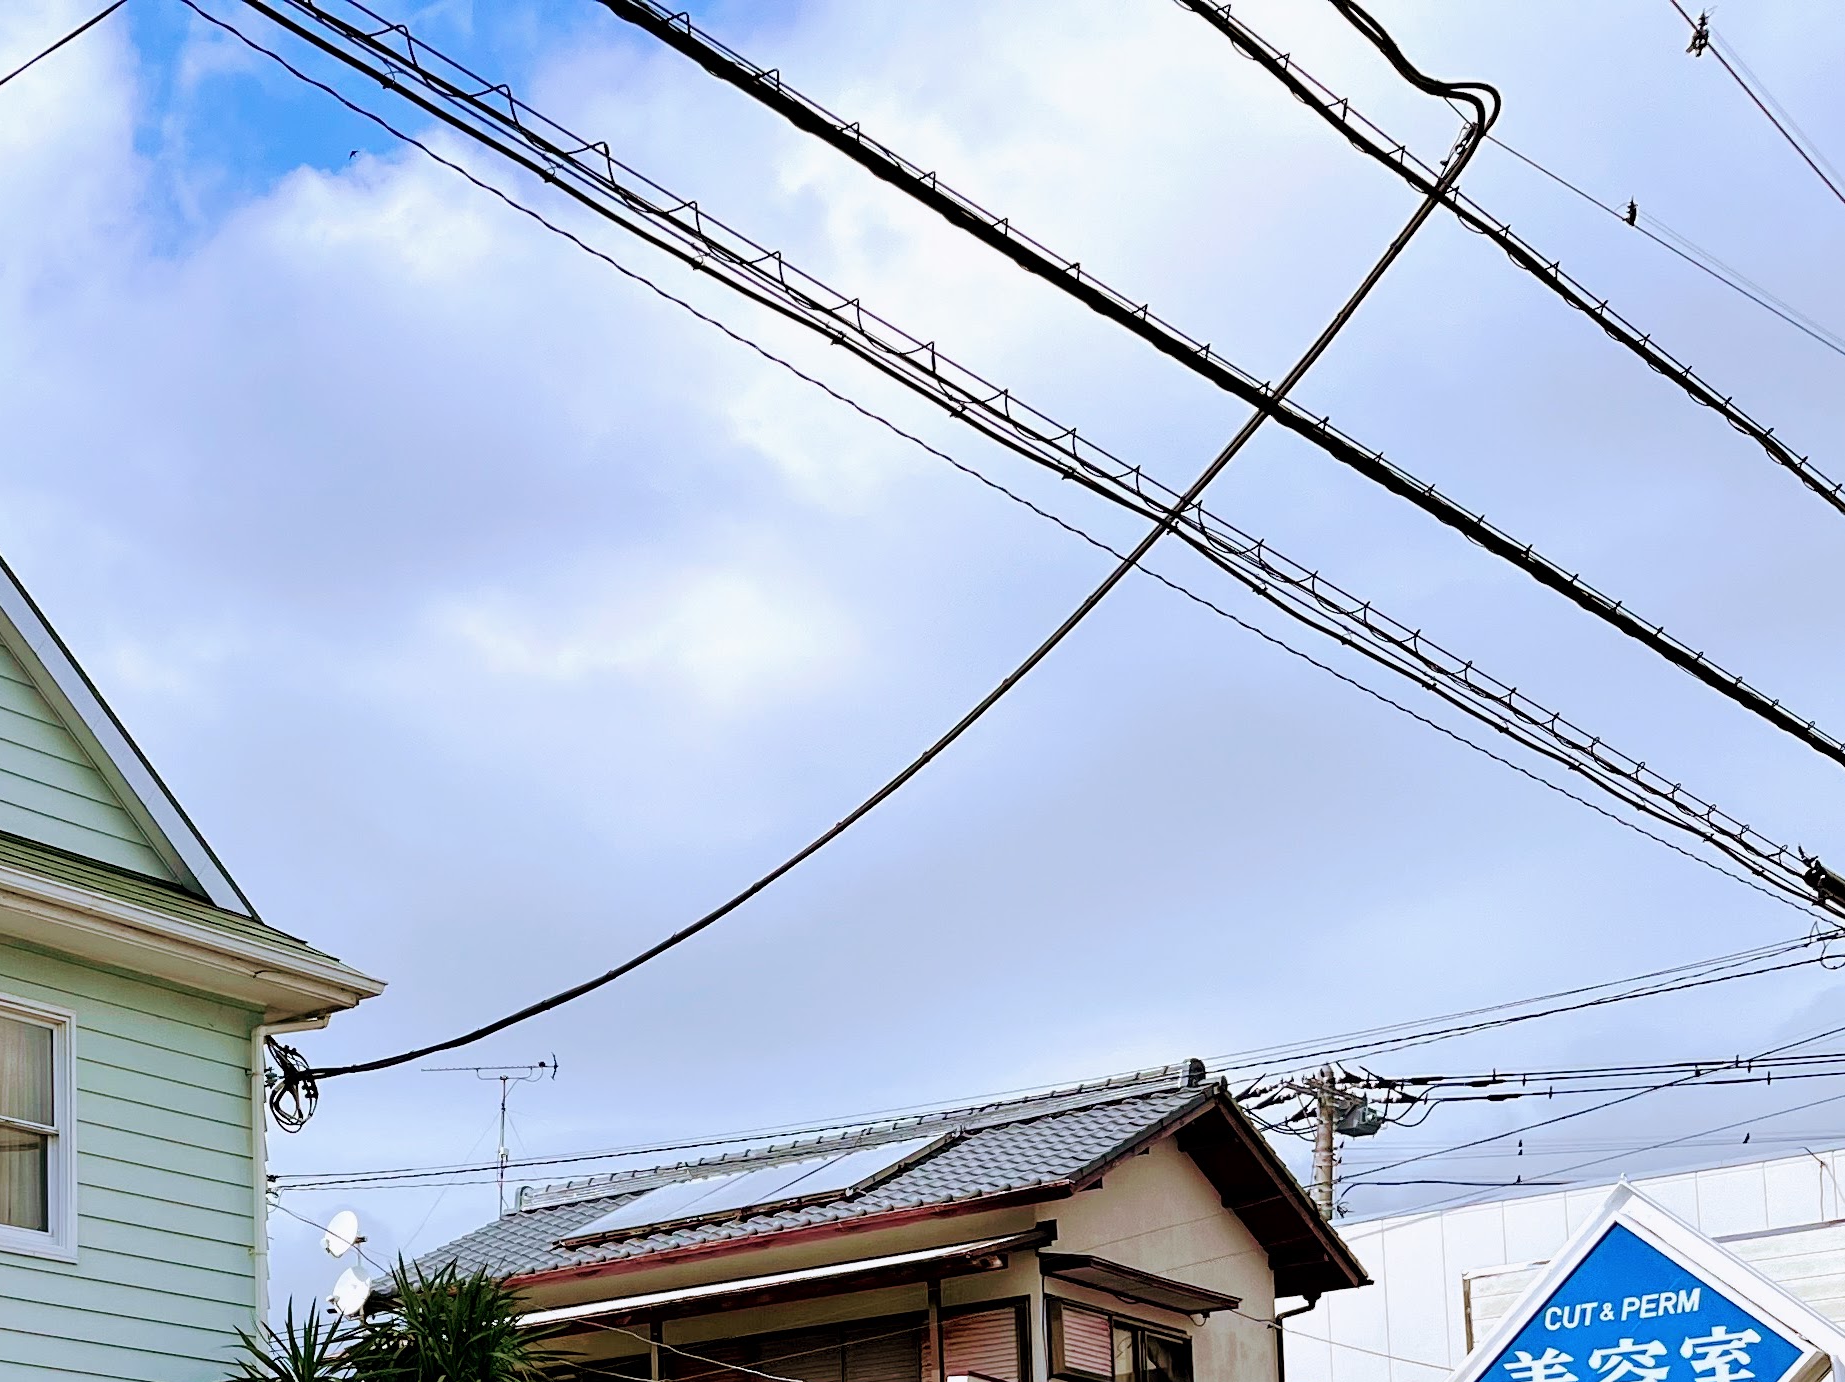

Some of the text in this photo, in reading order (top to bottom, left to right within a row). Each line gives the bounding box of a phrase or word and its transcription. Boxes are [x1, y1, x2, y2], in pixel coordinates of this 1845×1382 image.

[1544, 1287, 1701, 1331] CUT & PERM
